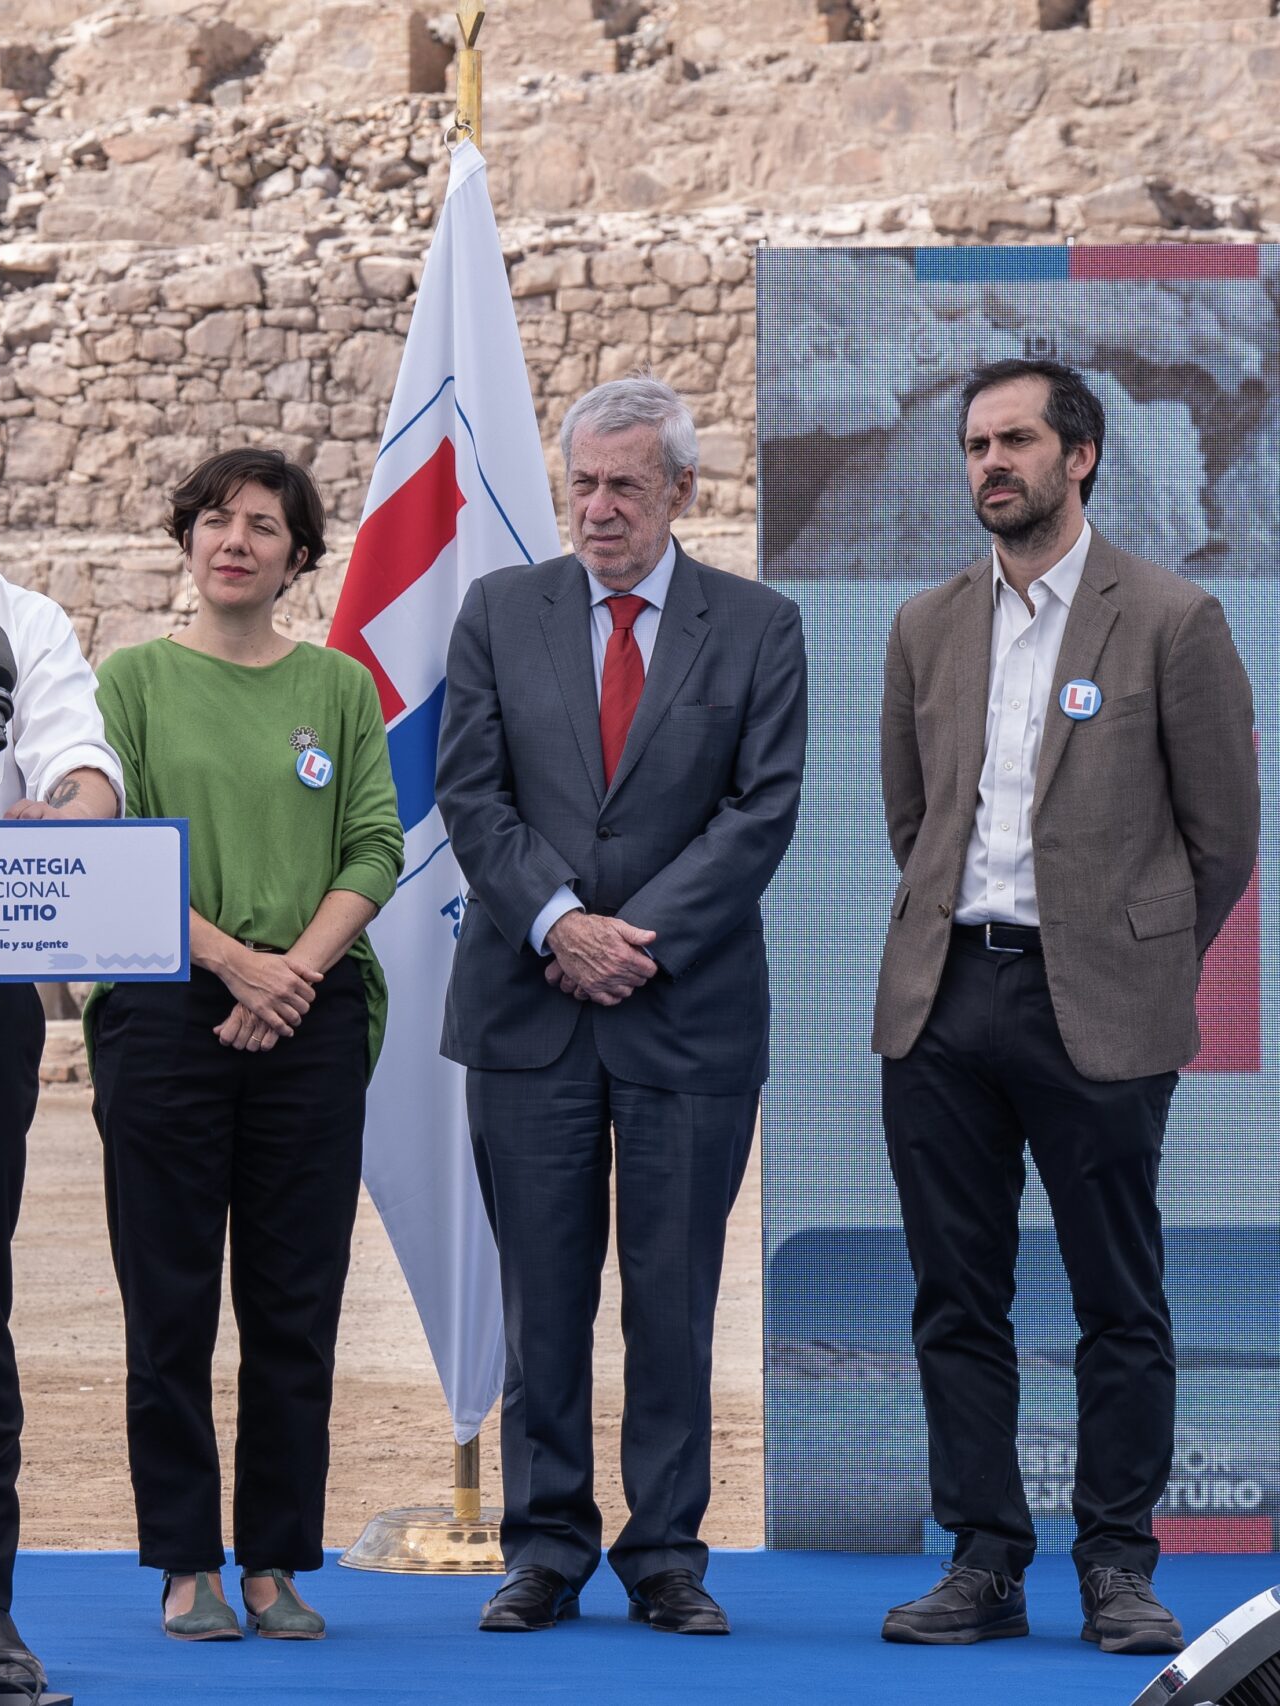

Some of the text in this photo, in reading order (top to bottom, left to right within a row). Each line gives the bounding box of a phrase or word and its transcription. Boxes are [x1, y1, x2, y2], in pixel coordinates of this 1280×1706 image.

[2, 904, 57, 921] LITIO
[11, 941, 20, 952] y
[21, 941, 34, 950] su
[35, 939, 69, 952] gente
